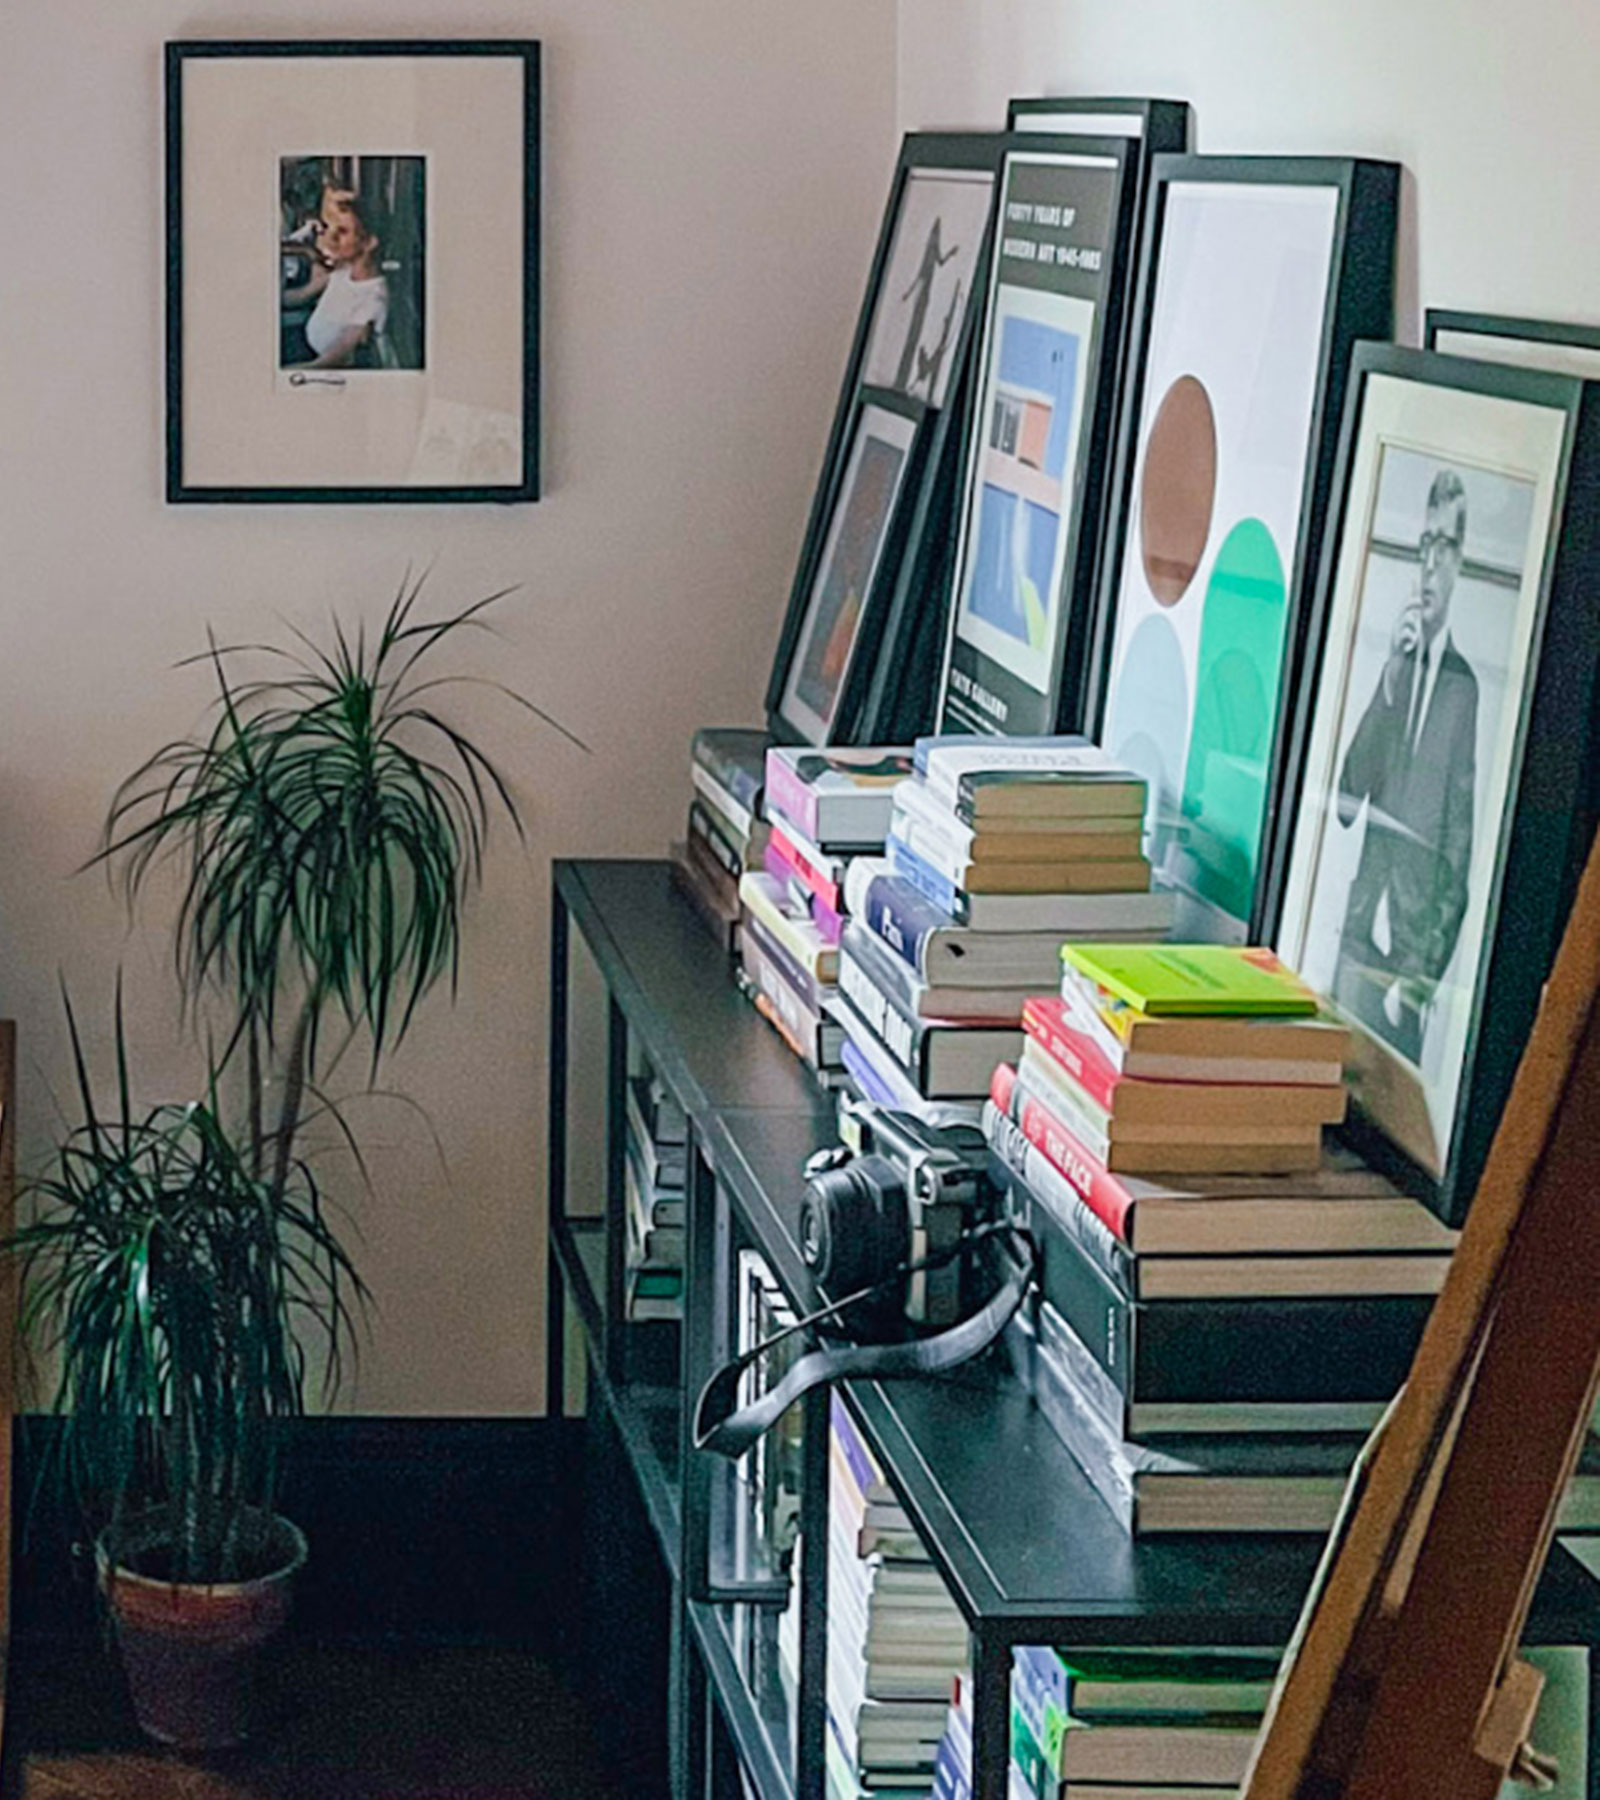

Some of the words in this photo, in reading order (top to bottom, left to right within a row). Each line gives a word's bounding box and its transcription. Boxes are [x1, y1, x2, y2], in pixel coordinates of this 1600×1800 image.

[1034, 205, 1061, 227] YEARS
[1062, 208, 1076, 228] OF
[1038, 242, 1055, 264] ART
